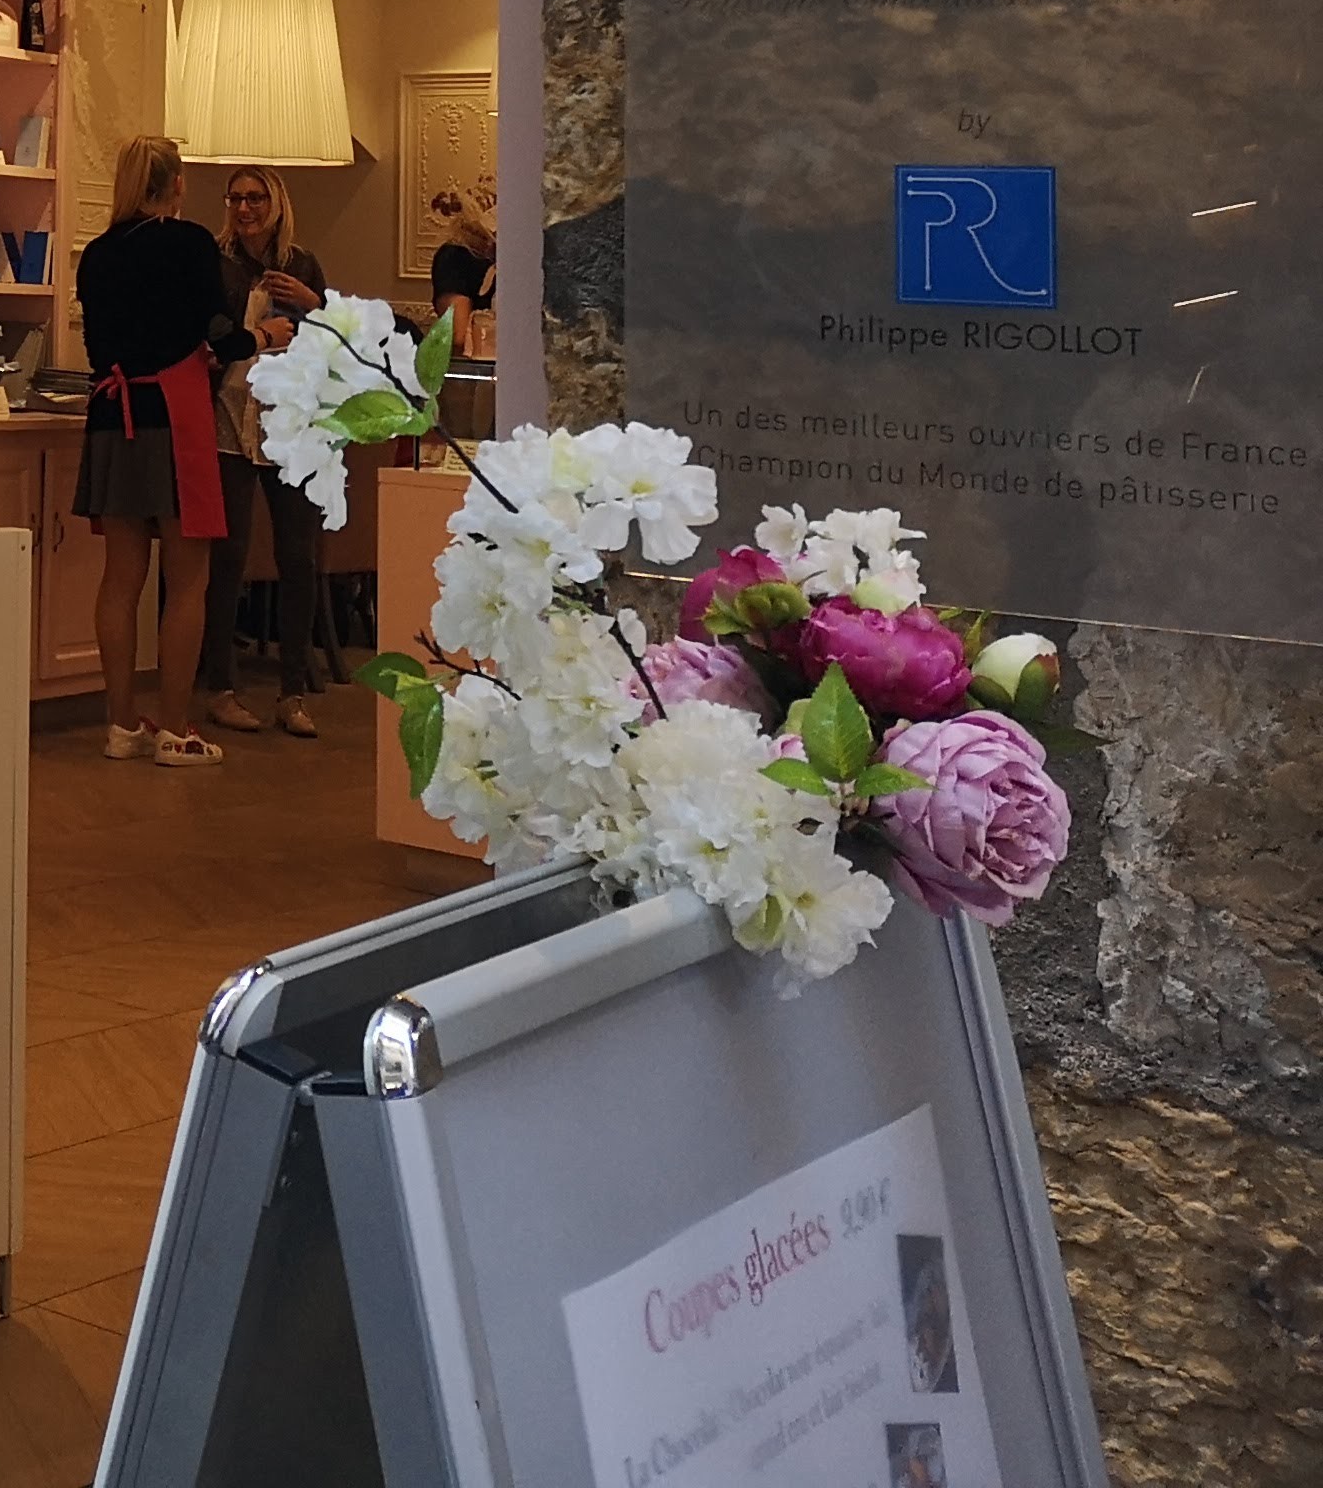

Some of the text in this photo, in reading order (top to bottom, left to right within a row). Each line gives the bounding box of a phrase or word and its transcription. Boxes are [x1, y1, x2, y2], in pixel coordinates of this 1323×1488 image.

[957, 108, 993, 140] by
[819, 314, 1143, 357] Philippe RIGOLLOT
[683, 400, 1308, 467] Un des meilleurs ouvriers de France
[695, 444, 1280, 515] Champion du Monde de pâtisserie
[744, 1211, 832, 1307] glacées
